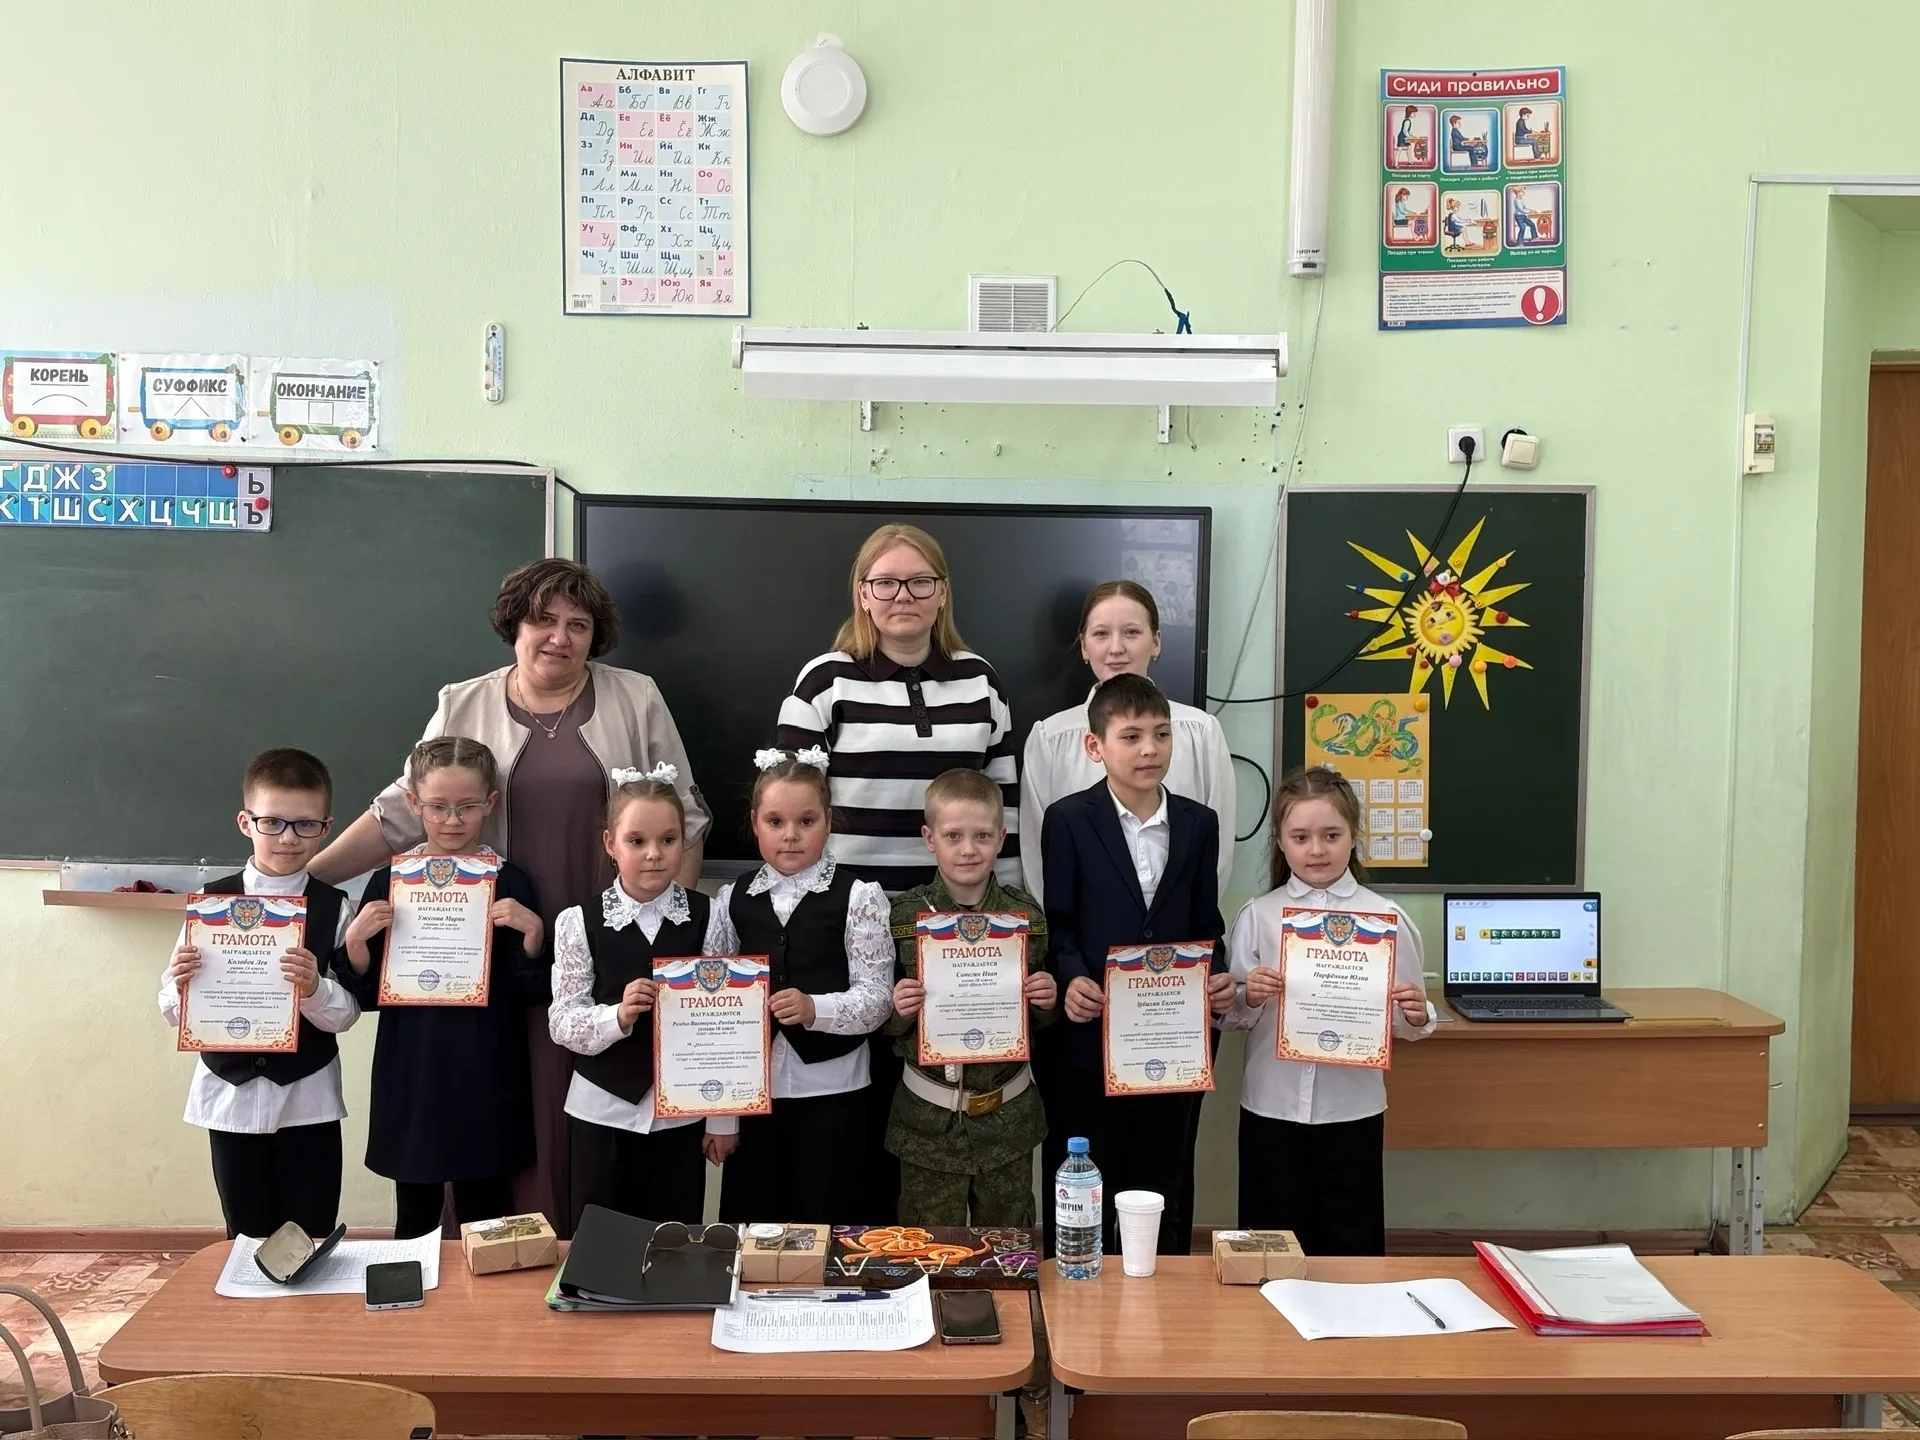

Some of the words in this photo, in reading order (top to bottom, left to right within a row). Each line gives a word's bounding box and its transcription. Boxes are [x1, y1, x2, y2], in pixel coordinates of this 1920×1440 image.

[616, 68, 695, 81] АЛФАВИТ
[1393, 78, 1441, 94] Сиди
[1447, 78, 1550, 94] правильно
[590, 94, 614, 109] Аа
[629, 94, 653, 109] Бб
[673, 95, 691, 110] Вв
[715, 96, 730, 110] Гг
[580, 113, 595, 121] Дд
[659, 112, 671, 122] Ёё
[660, 141, 673, 149] Йй
[621, 197, 633, 205] Рр
[582, 224, 594, 233] Уу
[621, 225, 637, 233] Фф
[700, 226, 713, 234] Цц
[661, 252, 680, 260] Щщ
[30, 368, 89, 383] КОРЕНЬ
[152, 378, 228, 394] СУФФИКС
[277, 382, 366, 399] ОКОНЧАНИЕ
[23, 467, 47, 492] Д
[54, 467, 81, 490] Ж
[90, 468, 108, 491] З
[249, 472, 264, 496] Ь
[27, 497, 46, 520] Т
[53, 497, 80, 521] Ш
[88, 499, 107, 521] С
[118, 499, 140, 522] Х
[150, 500, 171, 525] Ц
[182, 500, 200, 524] Ч
[209, 501, 236, 527] Щ
[410, 892, 469, 903] ГРАМОТА
[212, 934, 277, 946] ГРАМОТА
[942, 947, 1002, 959] ГРАМОТА
[1307, 948, 1369, 963] ГРАМОТА
[1316, 963, 1363, 971] НАГРАЖДАЕТСЯ
[1128, 976, 1186, 989] ГРАМОТА
[680, 996, 744, 1008] ГРАМОТА
